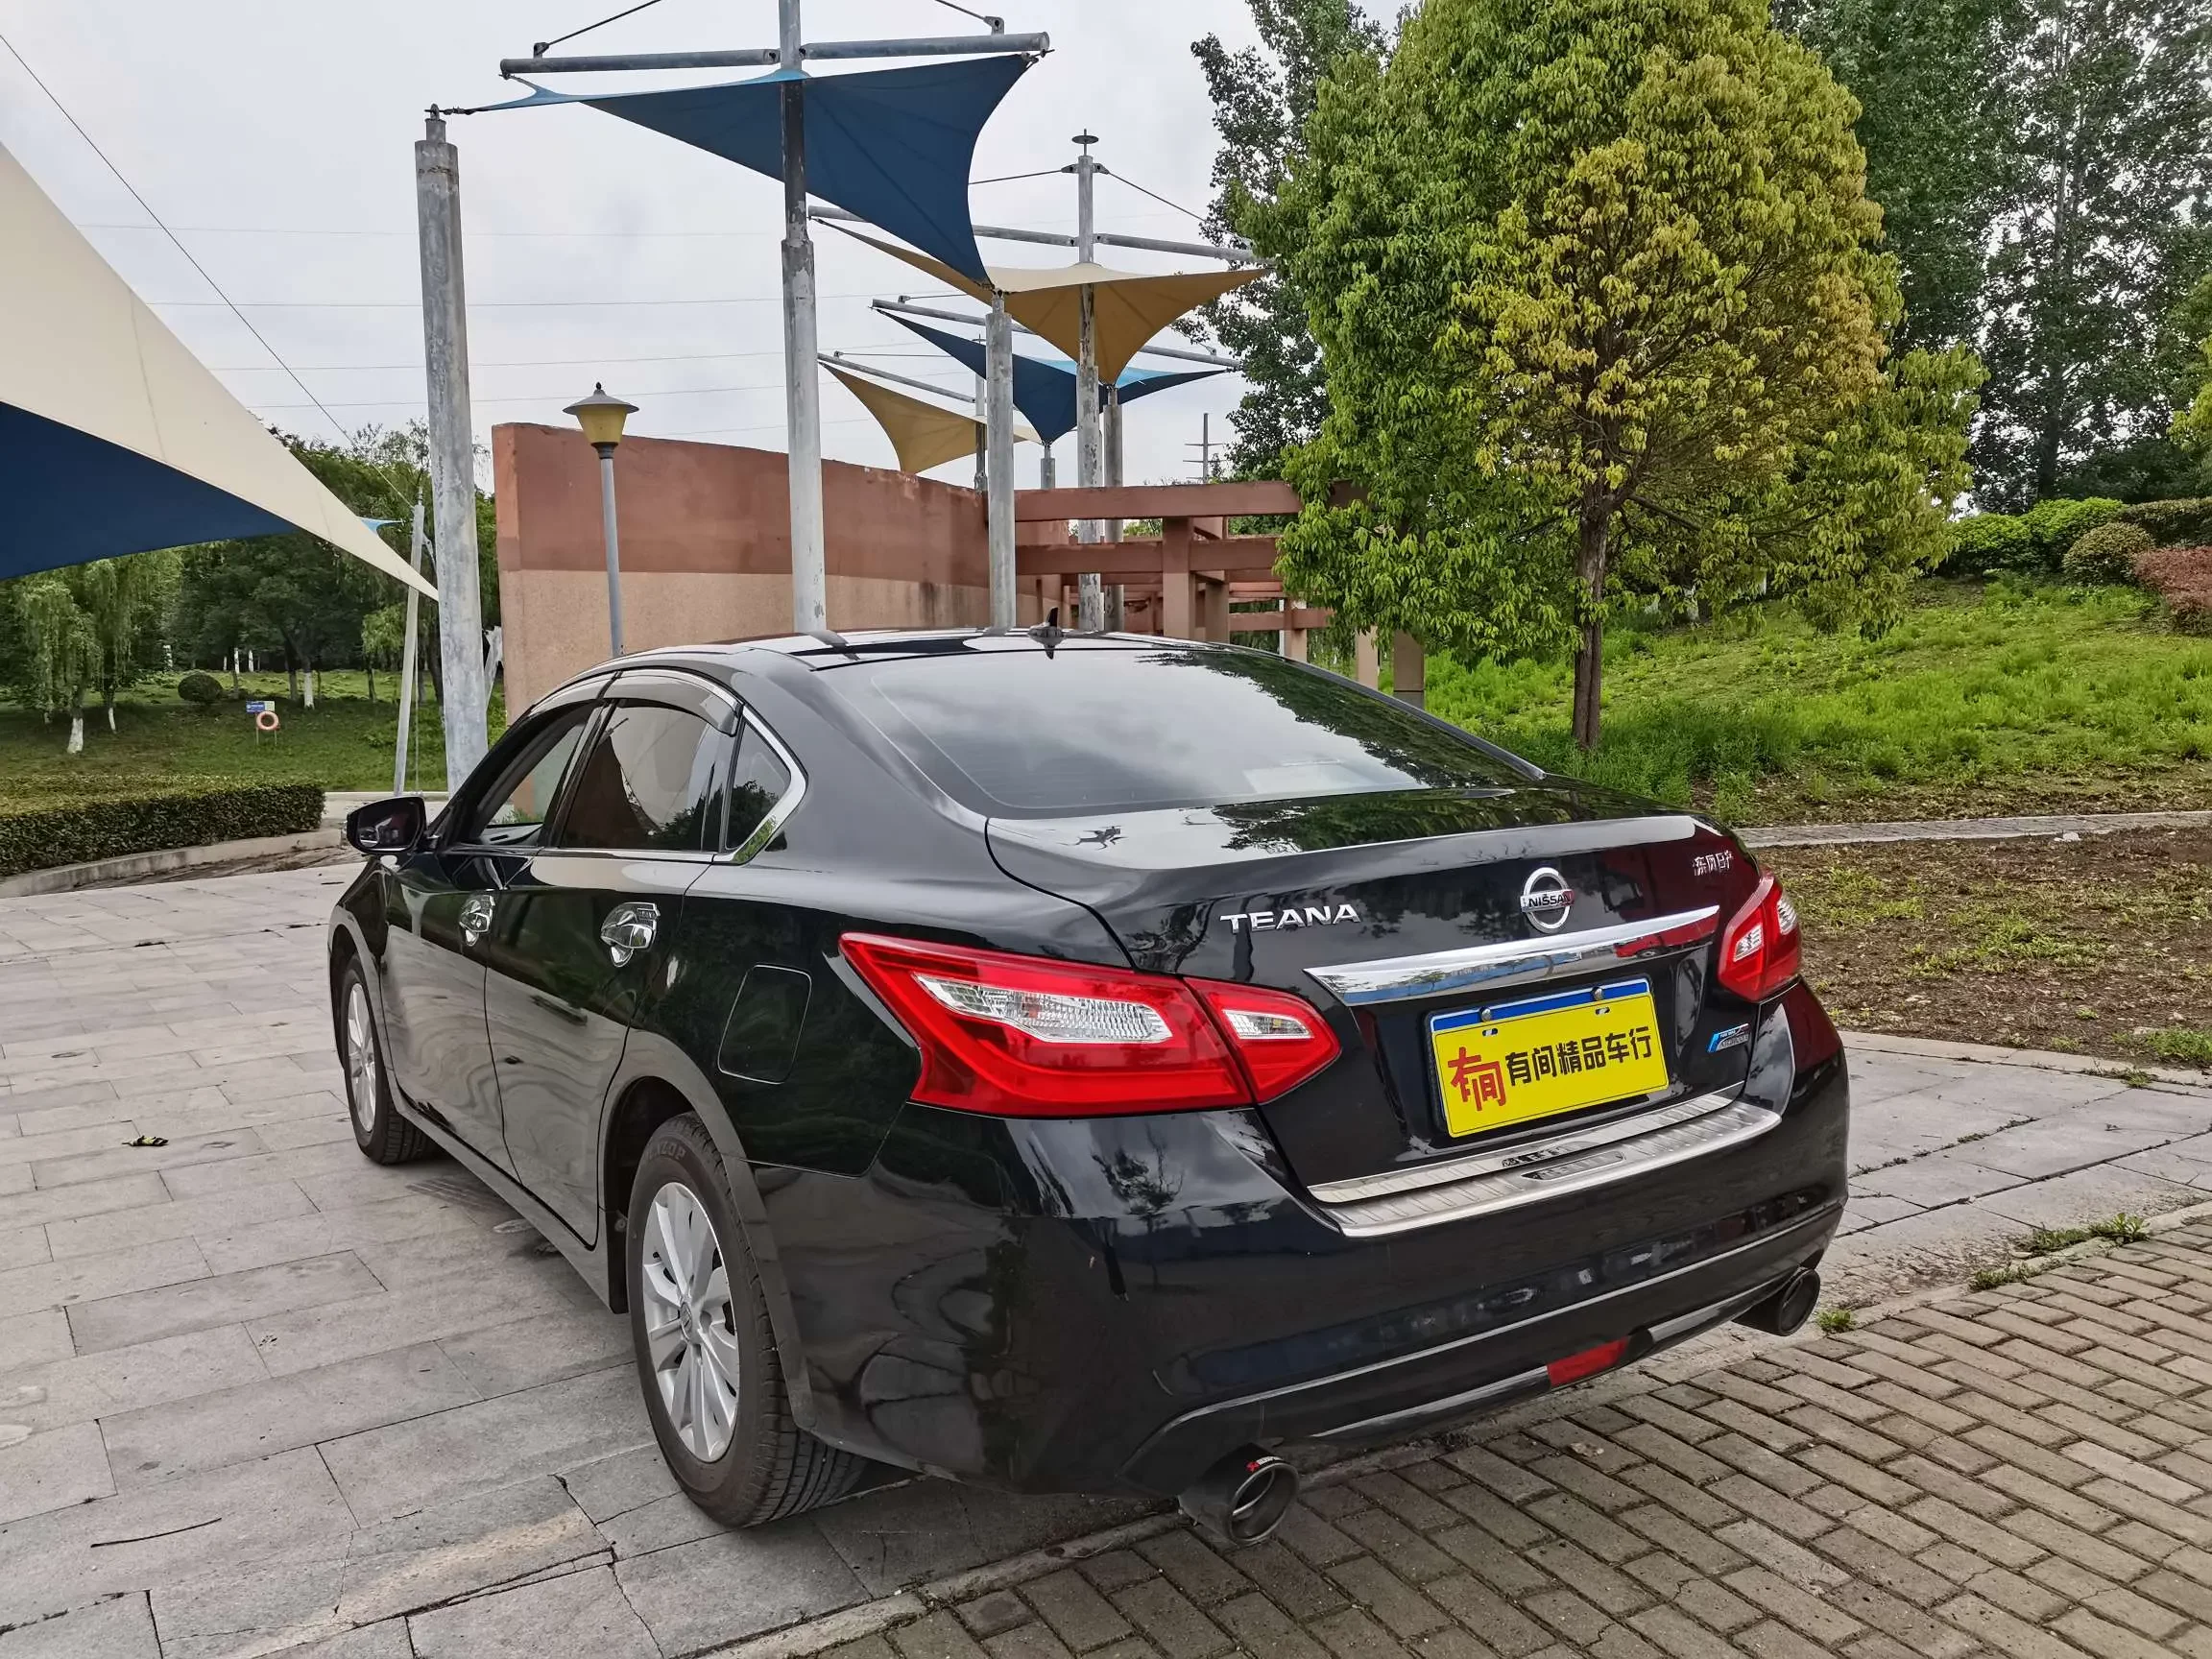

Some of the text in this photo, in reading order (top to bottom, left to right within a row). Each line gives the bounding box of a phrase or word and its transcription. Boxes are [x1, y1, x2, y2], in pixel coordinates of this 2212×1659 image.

[1528, 894, 1572, 908] NISSAN
[1219, 903, 1361, 934] TEANA
[1505, 1025, 1653, 1087] 有间精品车行
